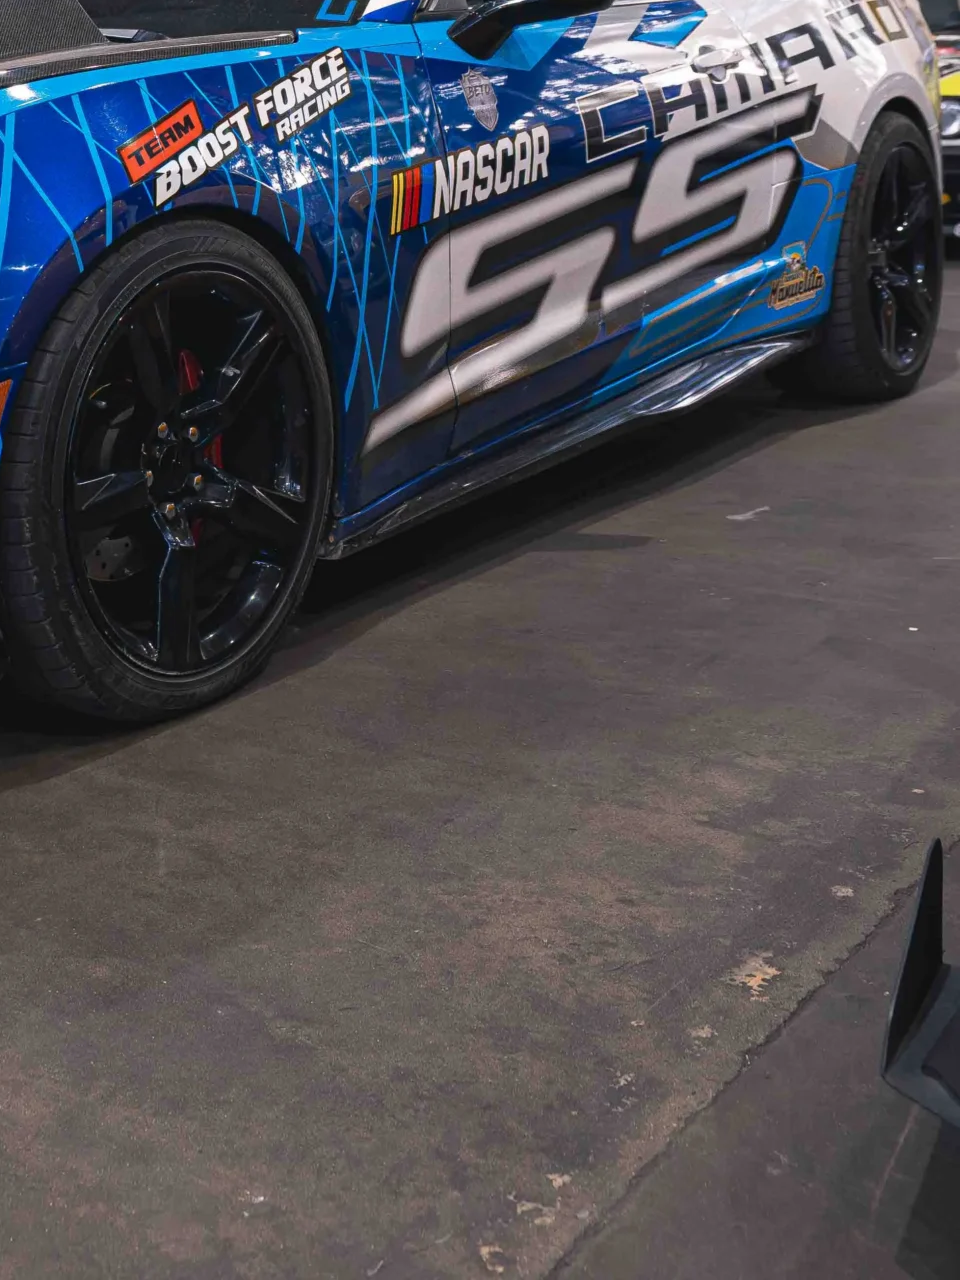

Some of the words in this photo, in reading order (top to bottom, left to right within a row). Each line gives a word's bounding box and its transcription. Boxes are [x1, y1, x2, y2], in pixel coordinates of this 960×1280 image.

[127, 114, 196, 167] TEAM
[155, 105, 252, 207] BOOST
[254, 46, 347, 126] FORCE
[276, 76, 351, 142] RACING
[432, 124, 551, 220] NASCAR
[360, 83, 823, 457] SS
